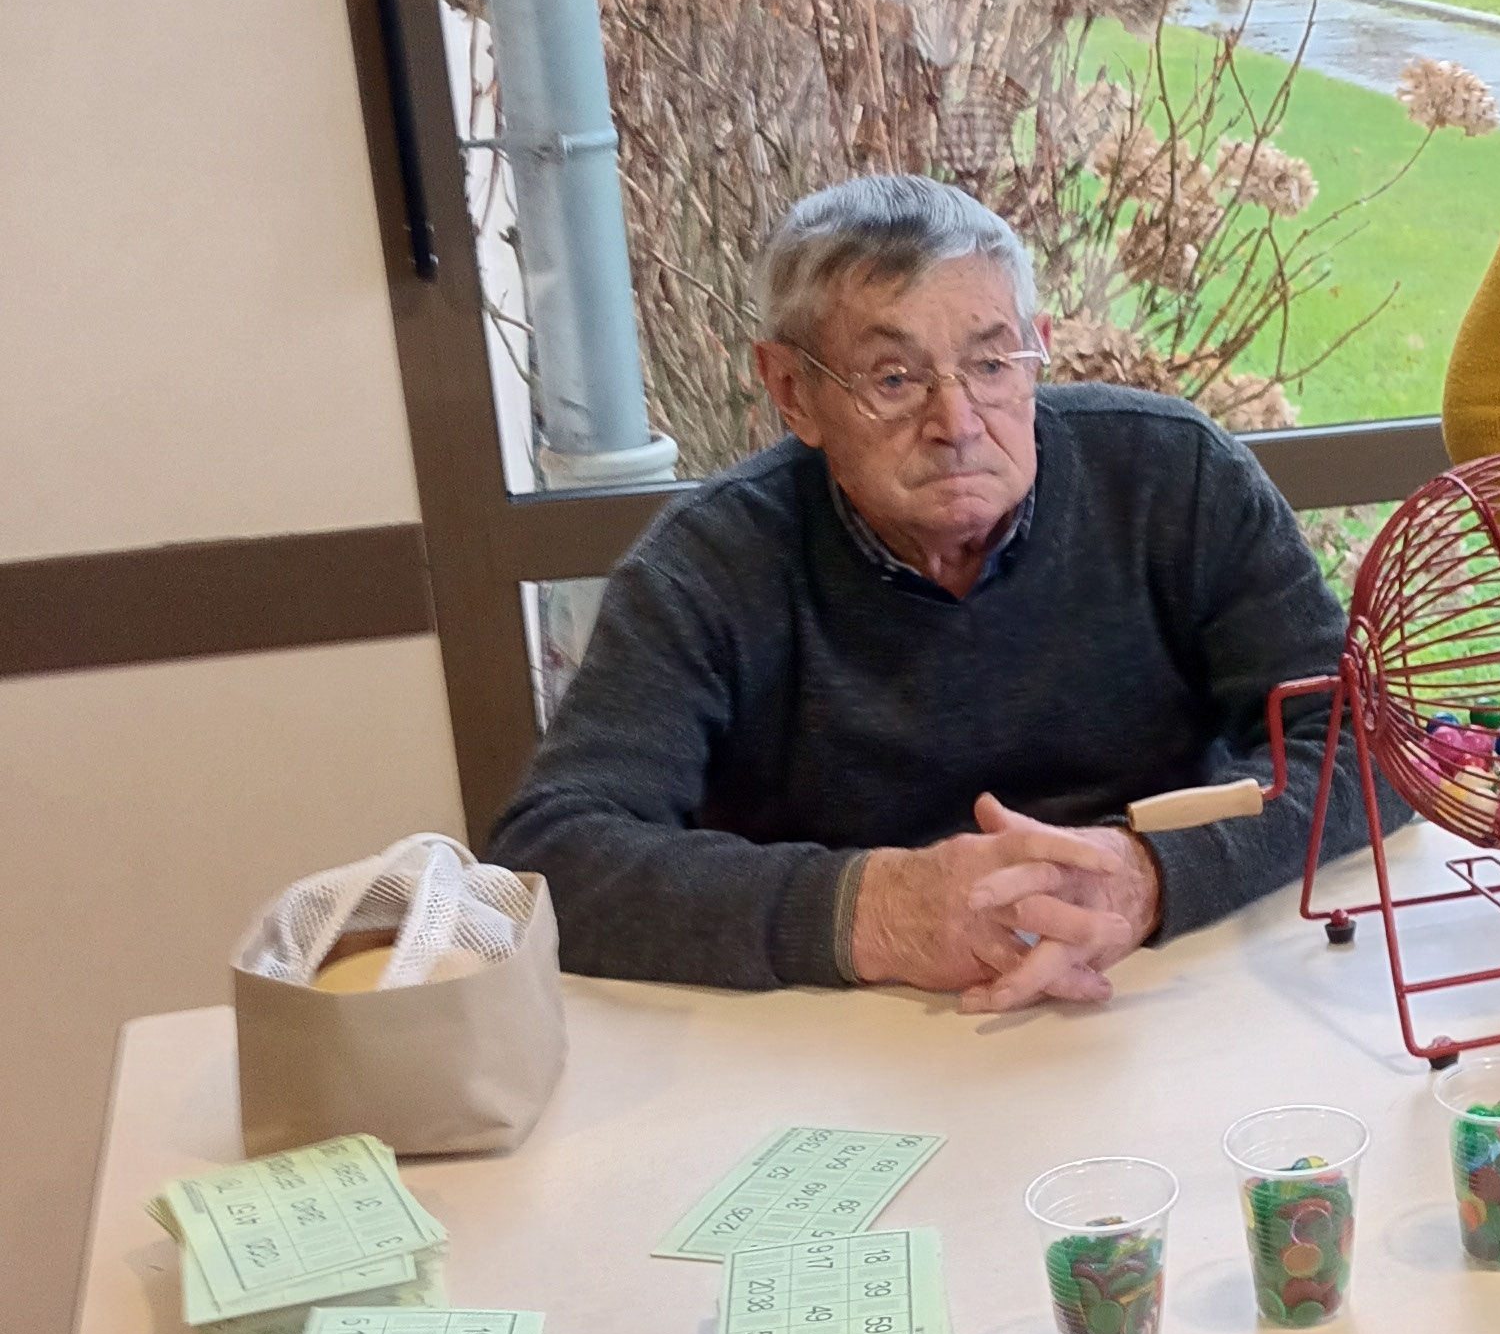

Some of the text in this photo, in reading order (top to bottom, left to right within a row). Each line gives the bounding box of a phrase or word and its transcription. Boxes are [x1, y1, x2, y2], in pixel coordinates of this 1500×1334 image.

[792, 1141, 821, 1155] 73
[767, 1166, 796, 1180] 52
[786, 1196, 814, 1211] 31
[800, 1182, 827, 1197] 49
[825, 1156, 851, 1171] 64
[725, 1207, 754, 1222] 26
[832, 1199, 861, 1215] 39
[712, 1222, 741, 1236] 12
[375, 1236, 404, 1249] 3
[807, 1244, 834, 1254] 9
[807, 1256, 834, 1269] 17
[864, 1249, 891, 1264] 18
[748, 1278, 775, 1295] 20
[864, 1280, 892, 1297] 39
[747, 1295, 775, 1313] 38
[805, 1305, 833, 1322] 49
[864, 1317, 893, 1334] 59
